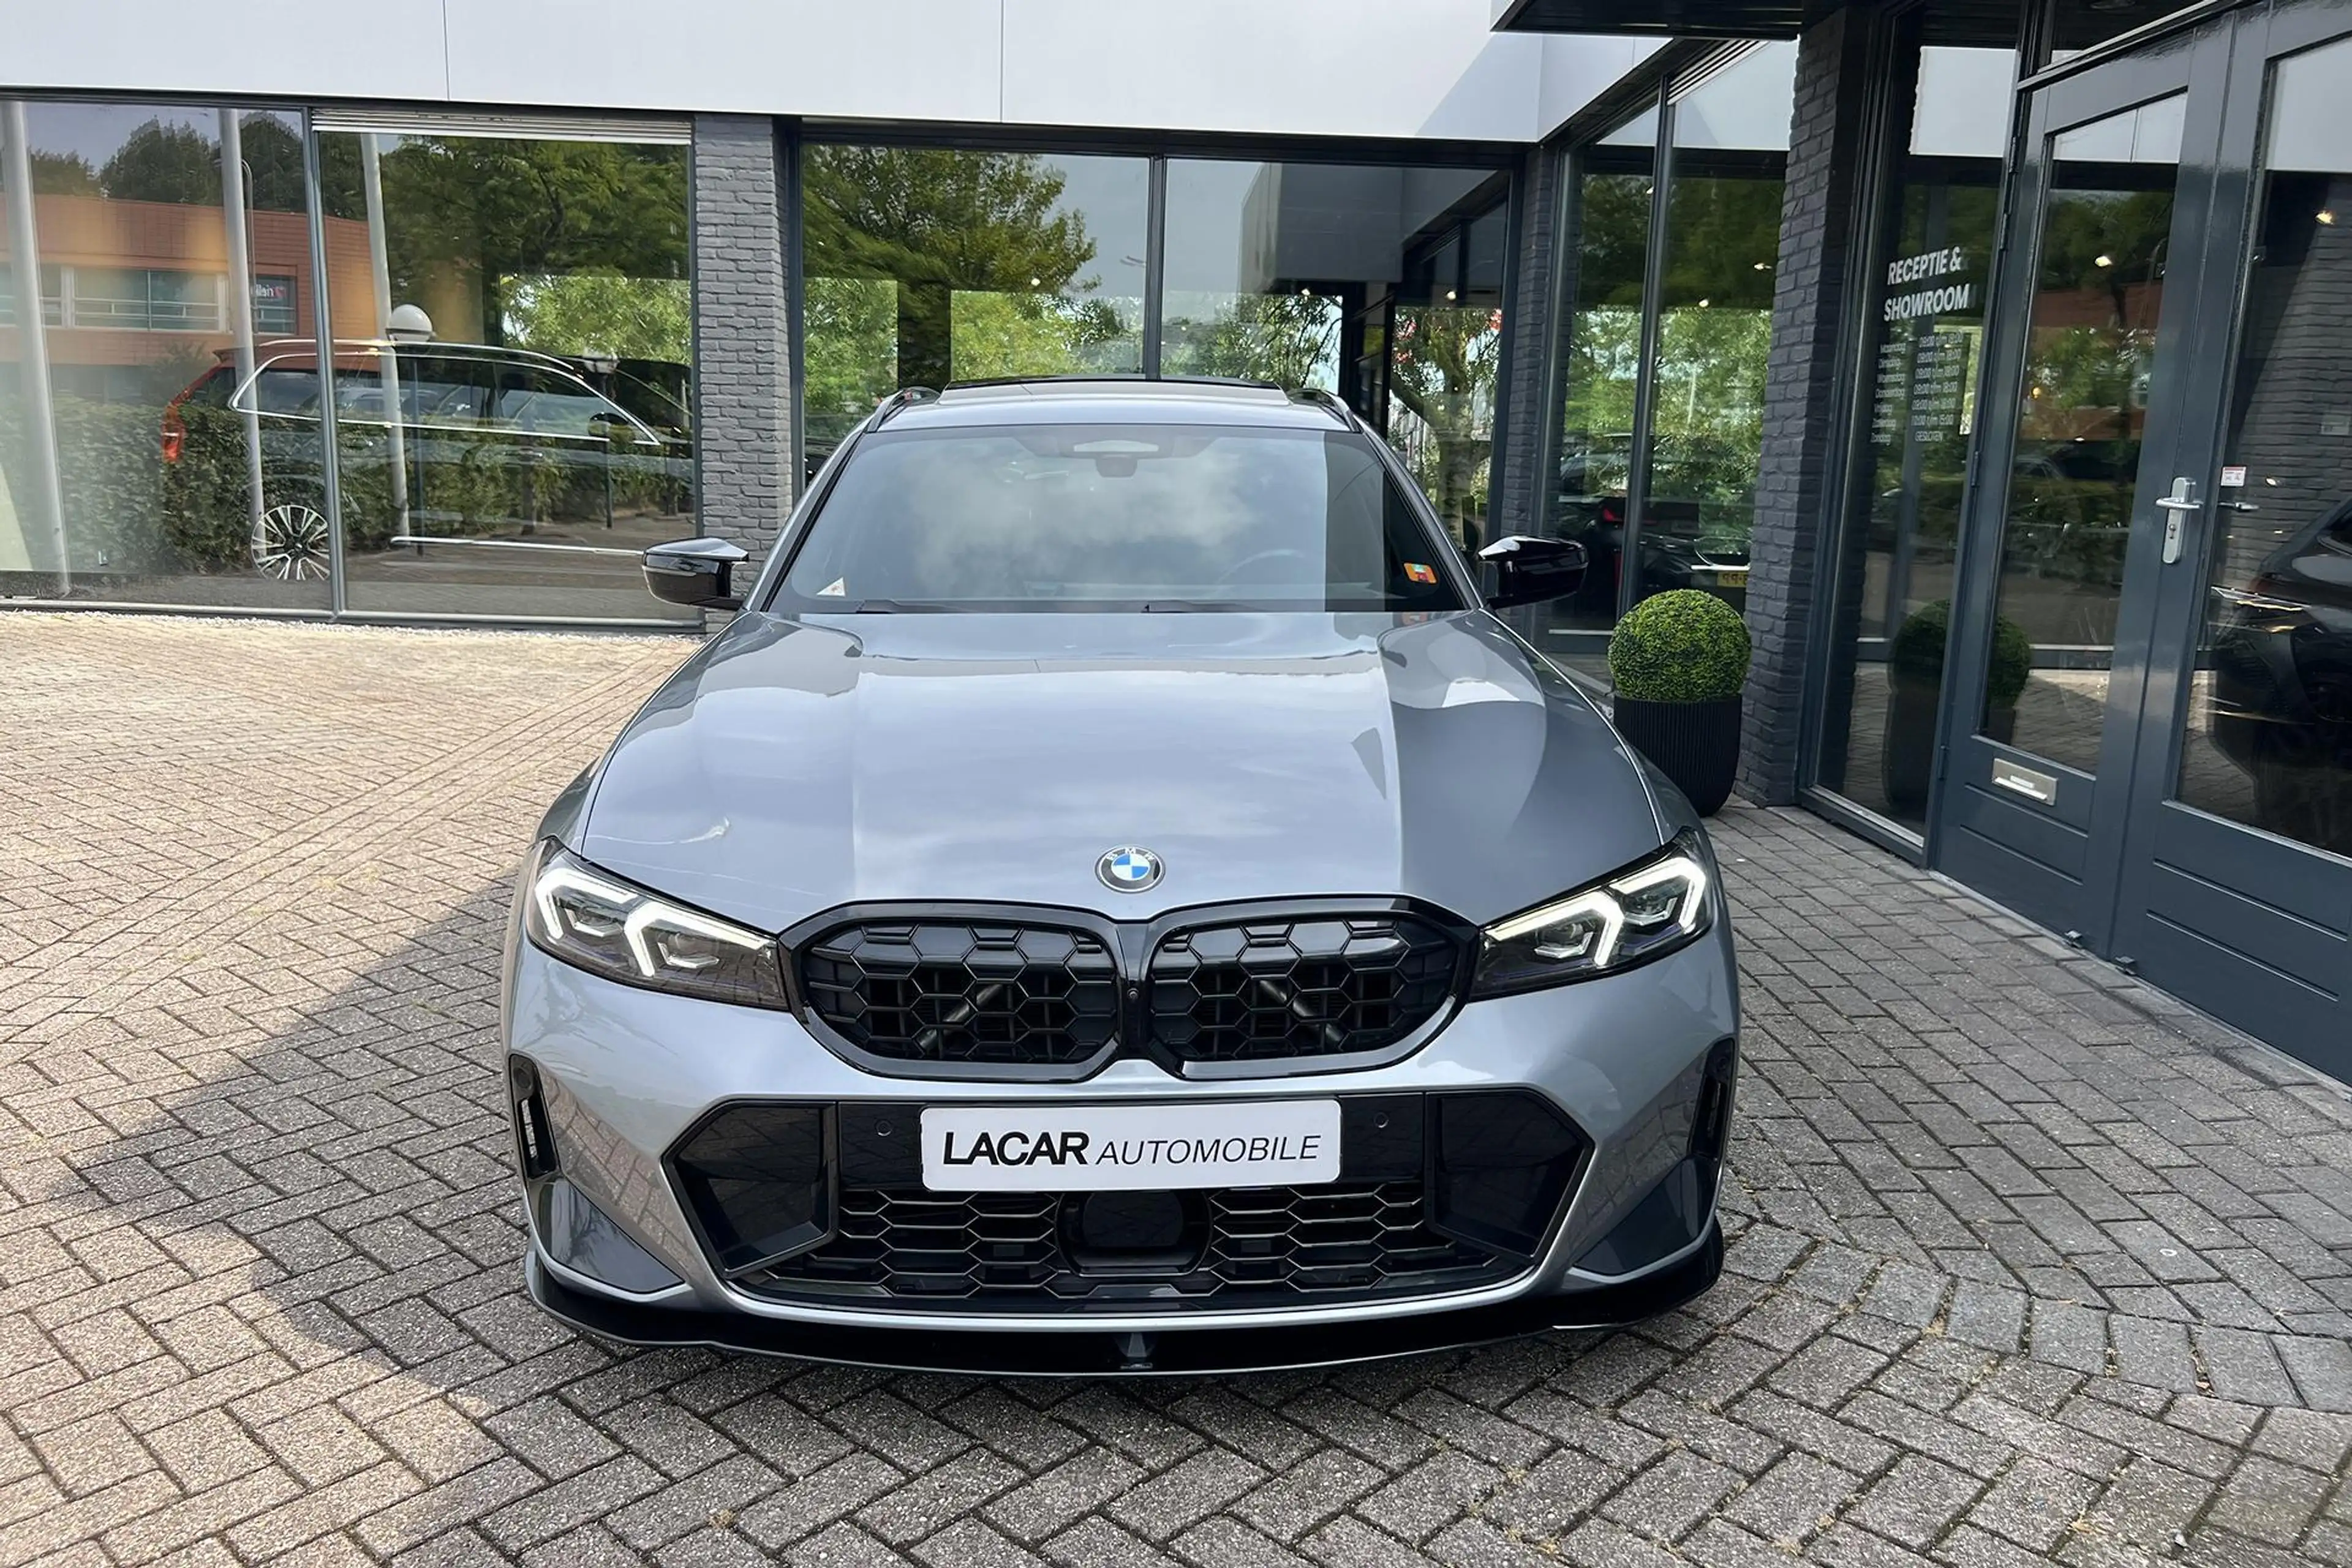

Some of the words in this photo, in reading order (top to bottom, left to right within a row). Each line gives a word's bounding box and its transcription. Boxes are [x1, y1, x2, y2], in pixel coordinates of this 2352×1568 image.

[1887, 249, 1949, 285] RECEPTIE
[1950, 246, 1961, 271] &
[1884, 283, 1970, 322] SHOWROOM
[943, 1131, 1090, 1166] LACAR
[1095, 1134, 1322, 1165] AUTOMOBILE
